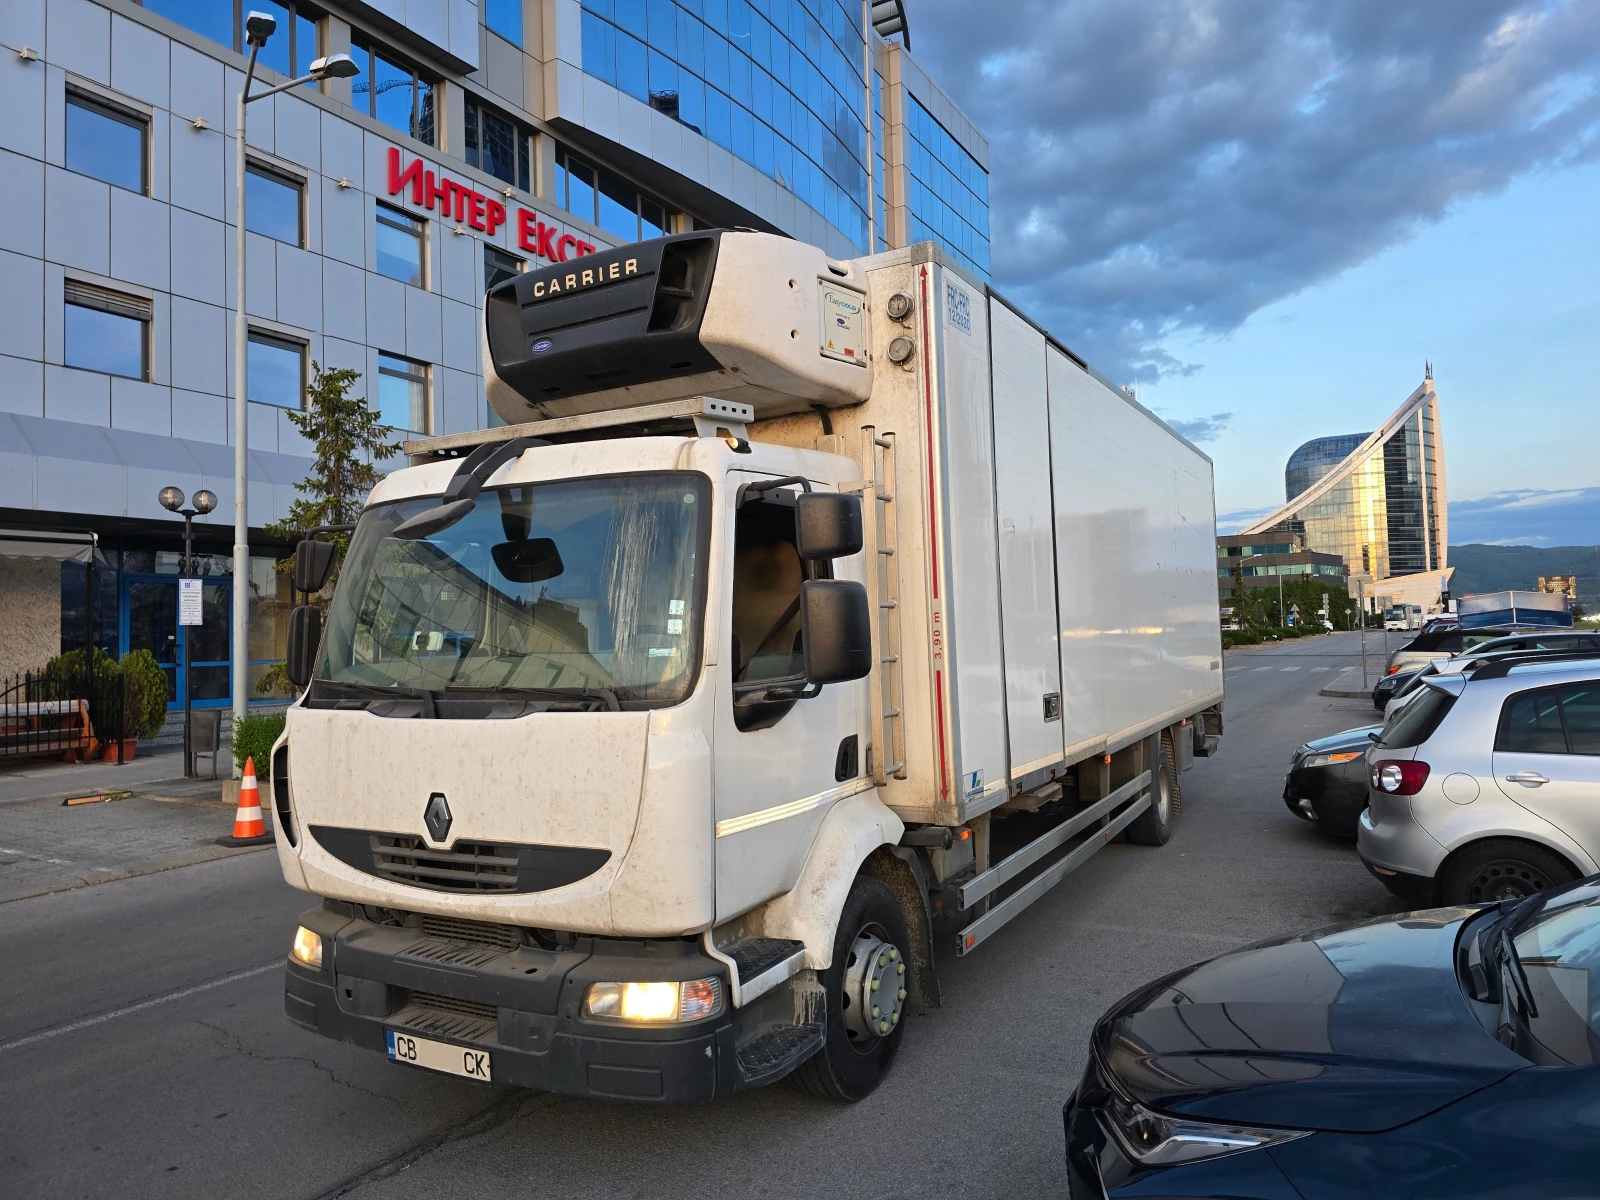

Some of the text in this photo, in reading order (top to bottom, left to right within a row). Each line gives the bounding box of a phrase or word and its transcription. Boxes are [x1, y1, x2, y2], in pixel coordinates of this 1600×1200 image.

[388, 147, 506, 236] ИНТЕР
[533, 258, 638, 297] CARRIER
[396, 1036, 486, 1077] CB CK
